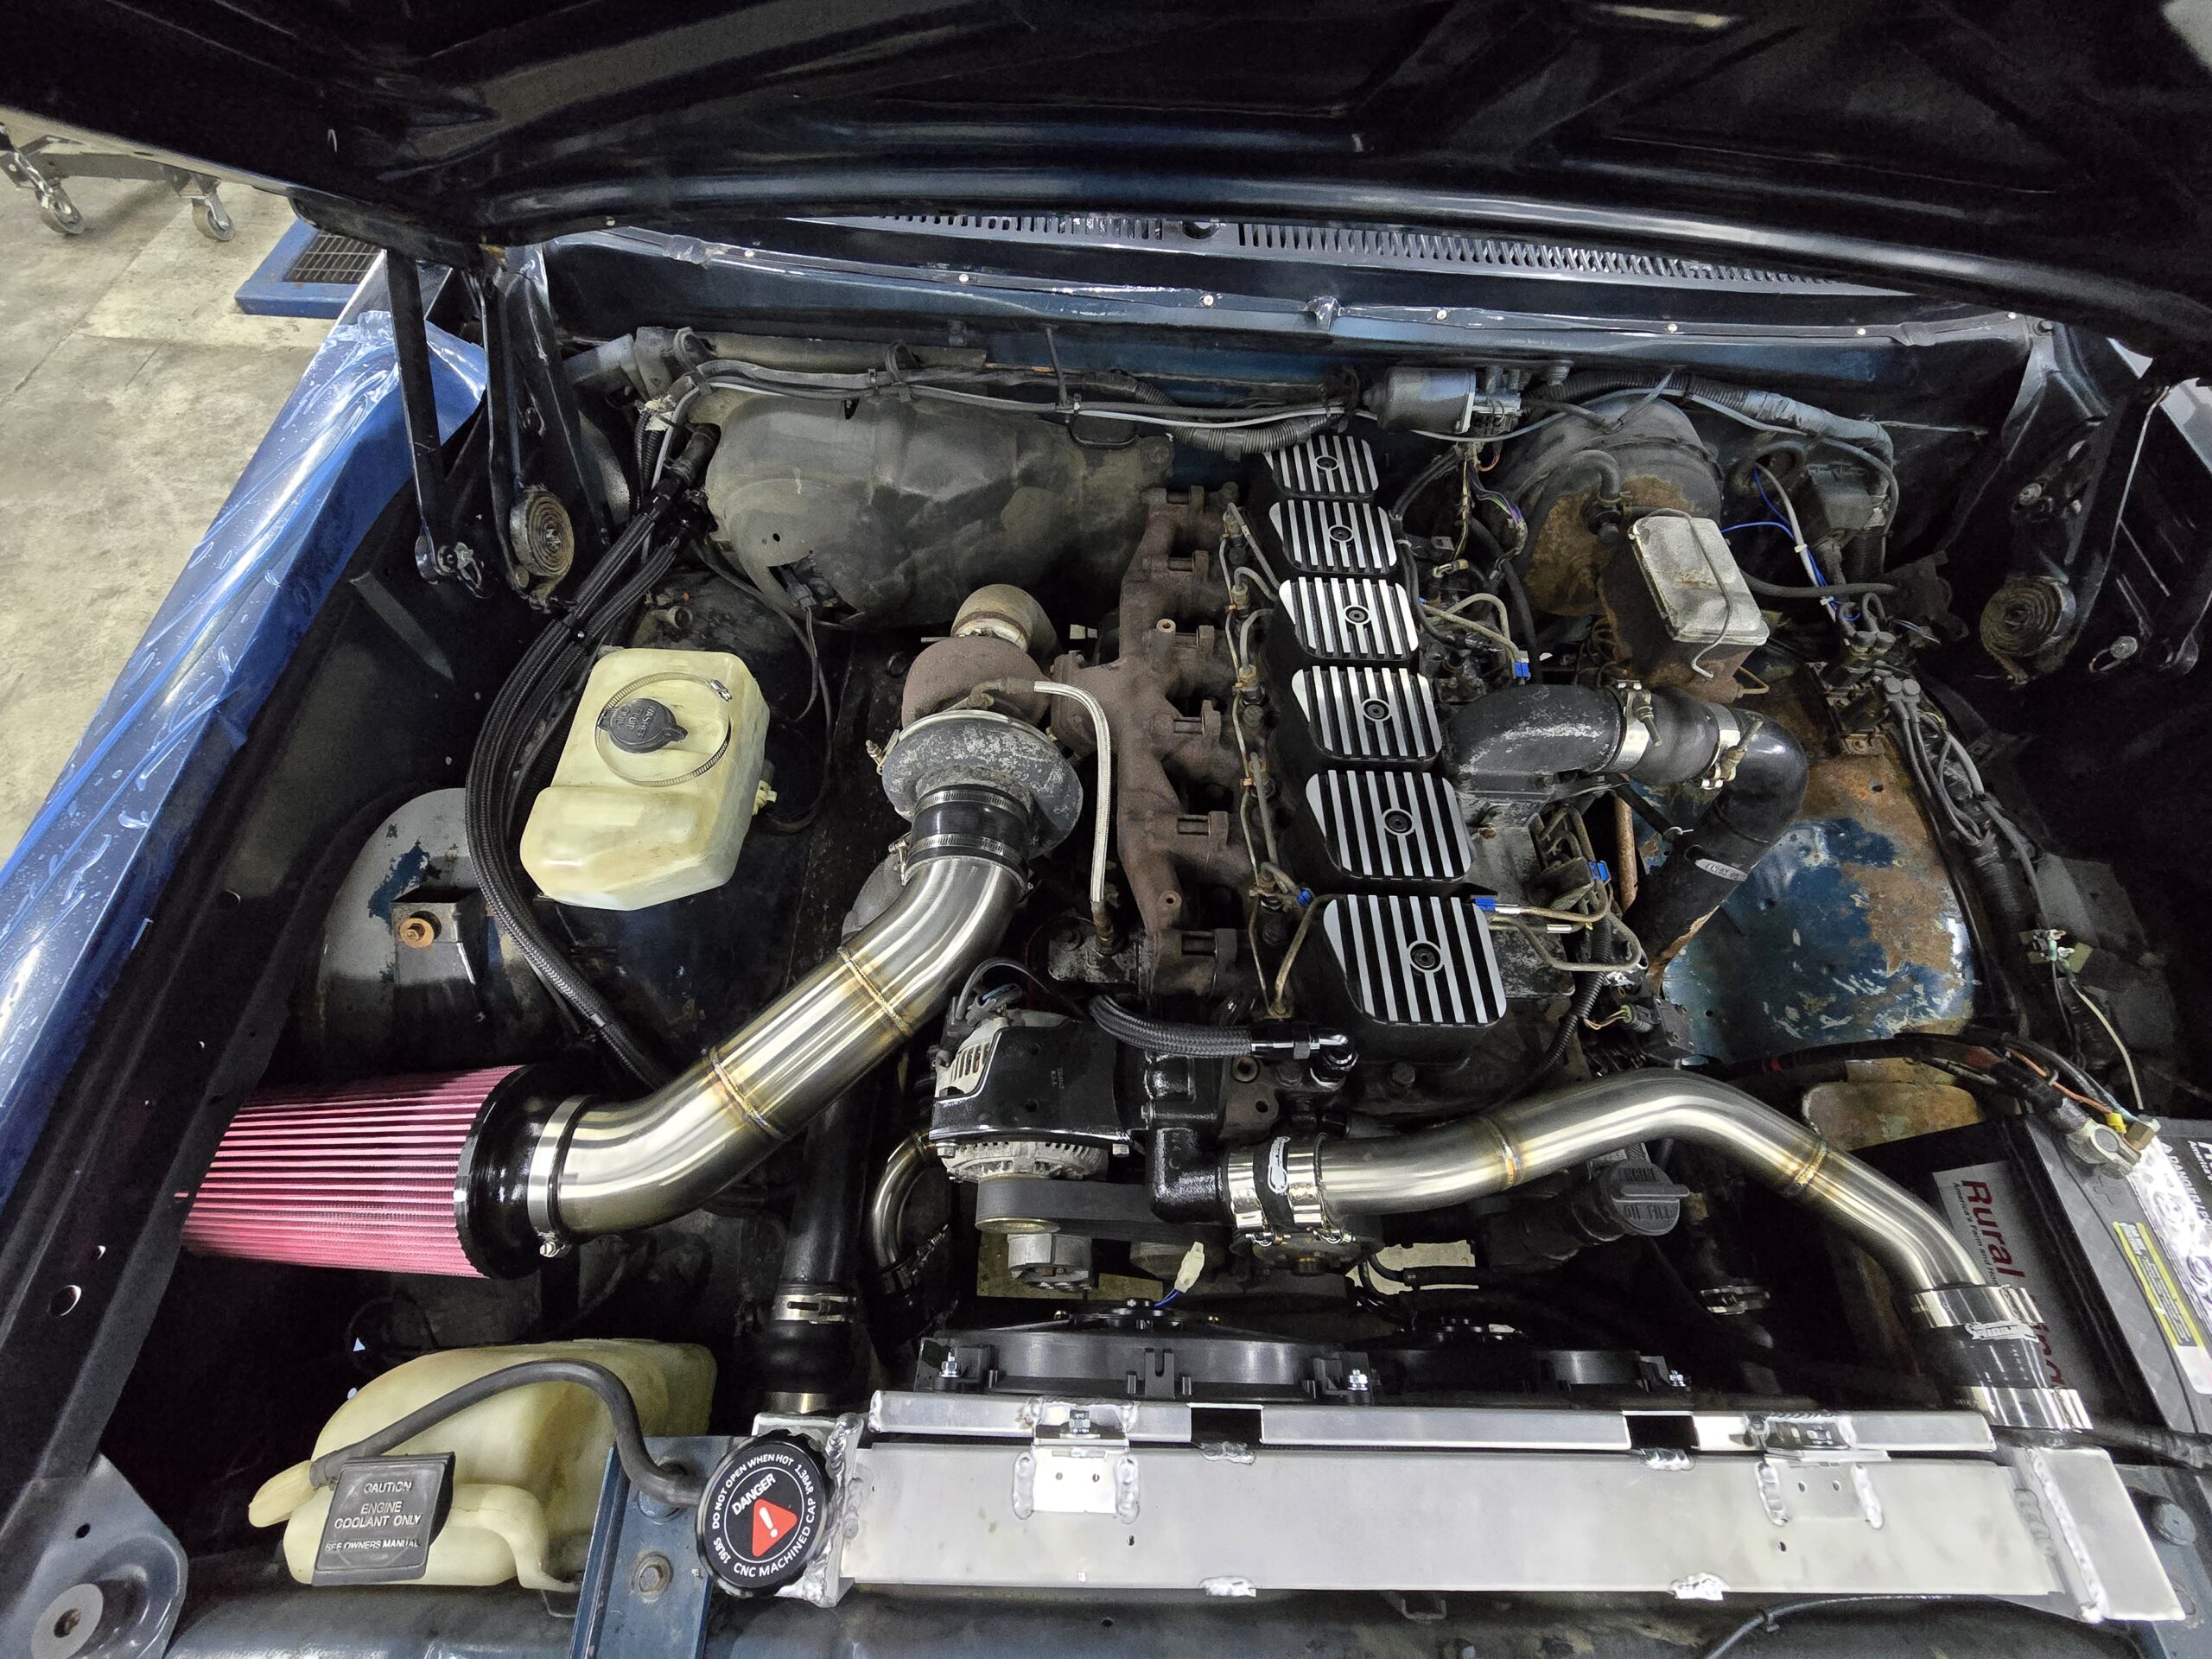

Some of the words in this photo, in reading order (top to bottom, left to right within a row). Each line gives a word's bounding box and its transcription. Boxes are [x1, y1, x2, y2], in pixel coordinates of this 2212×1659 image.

[1953, 1181, 1973, 1223] America's
[1970, 1224, 1982, 1247] Farm
[1979, 1248, 1992, 1266] and
[1961, 1180, 2025, 1277] Rural
[747, 1453, 775, 1468] WHEN
[775, 1453, 794, 1466] HOT
[725, 1464, 747, 1488] OPEN
[794, 1464, 814, 1495] 1.3BAR
[364, 1481, 412, 1493] CAUTION
[731, 1473, 777, 1516] DANGER
[360, 1501, 403, 1514] ENGINE
[715, 1489, 728, 1510] NOT
[334, 1516, 390, 1529] COOLANT
[393, 1515, 422, 1527] ONLY
[712, 1512, 721, 1529] DO
[325, 1541, 342, 1552] SEE
[343, 1540, 381, 1550] OWNERS
[382, 1538, 420, 1548] MANUAL
[733, 1562, 757, 1577] CNC
[759, 1527, 810, 1577] MACHINED
[805, 1498, 817, 1524] CAP
[713, 1536, 732, 1564] 19LBS
